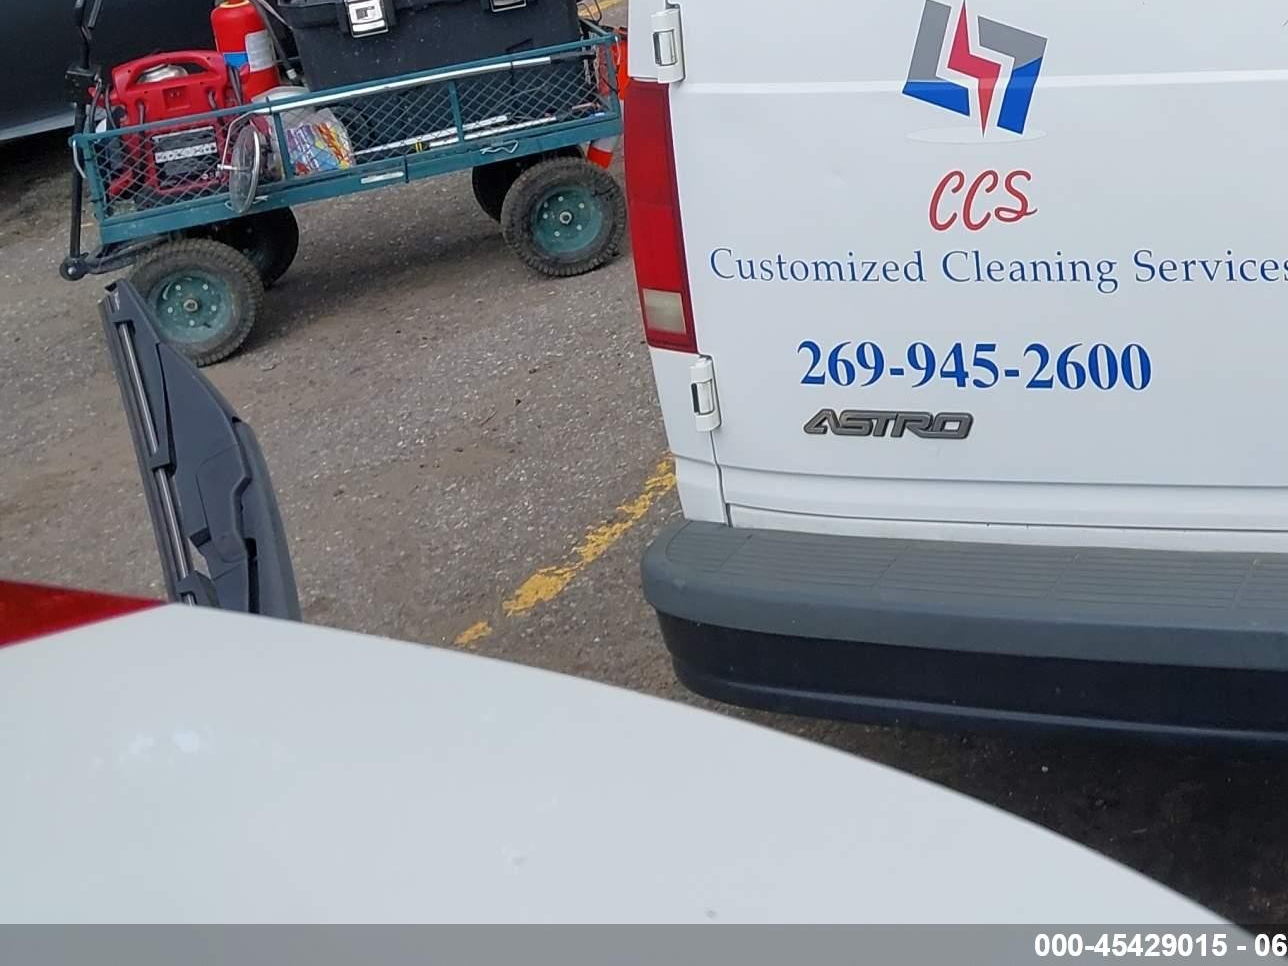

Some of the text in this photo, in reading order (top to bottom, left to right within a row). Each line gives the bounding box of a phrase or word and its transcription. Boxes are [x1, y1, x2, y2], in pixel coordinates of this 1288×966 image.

[929, 170, 1038, 231] CCS
[709, 248, 925, 284] Customized
[942, 249, 1119, 294] Cleaning
[798, 340, 1152, 391] 269-945-2600
[803, 408, 974, 440] ASTRO
